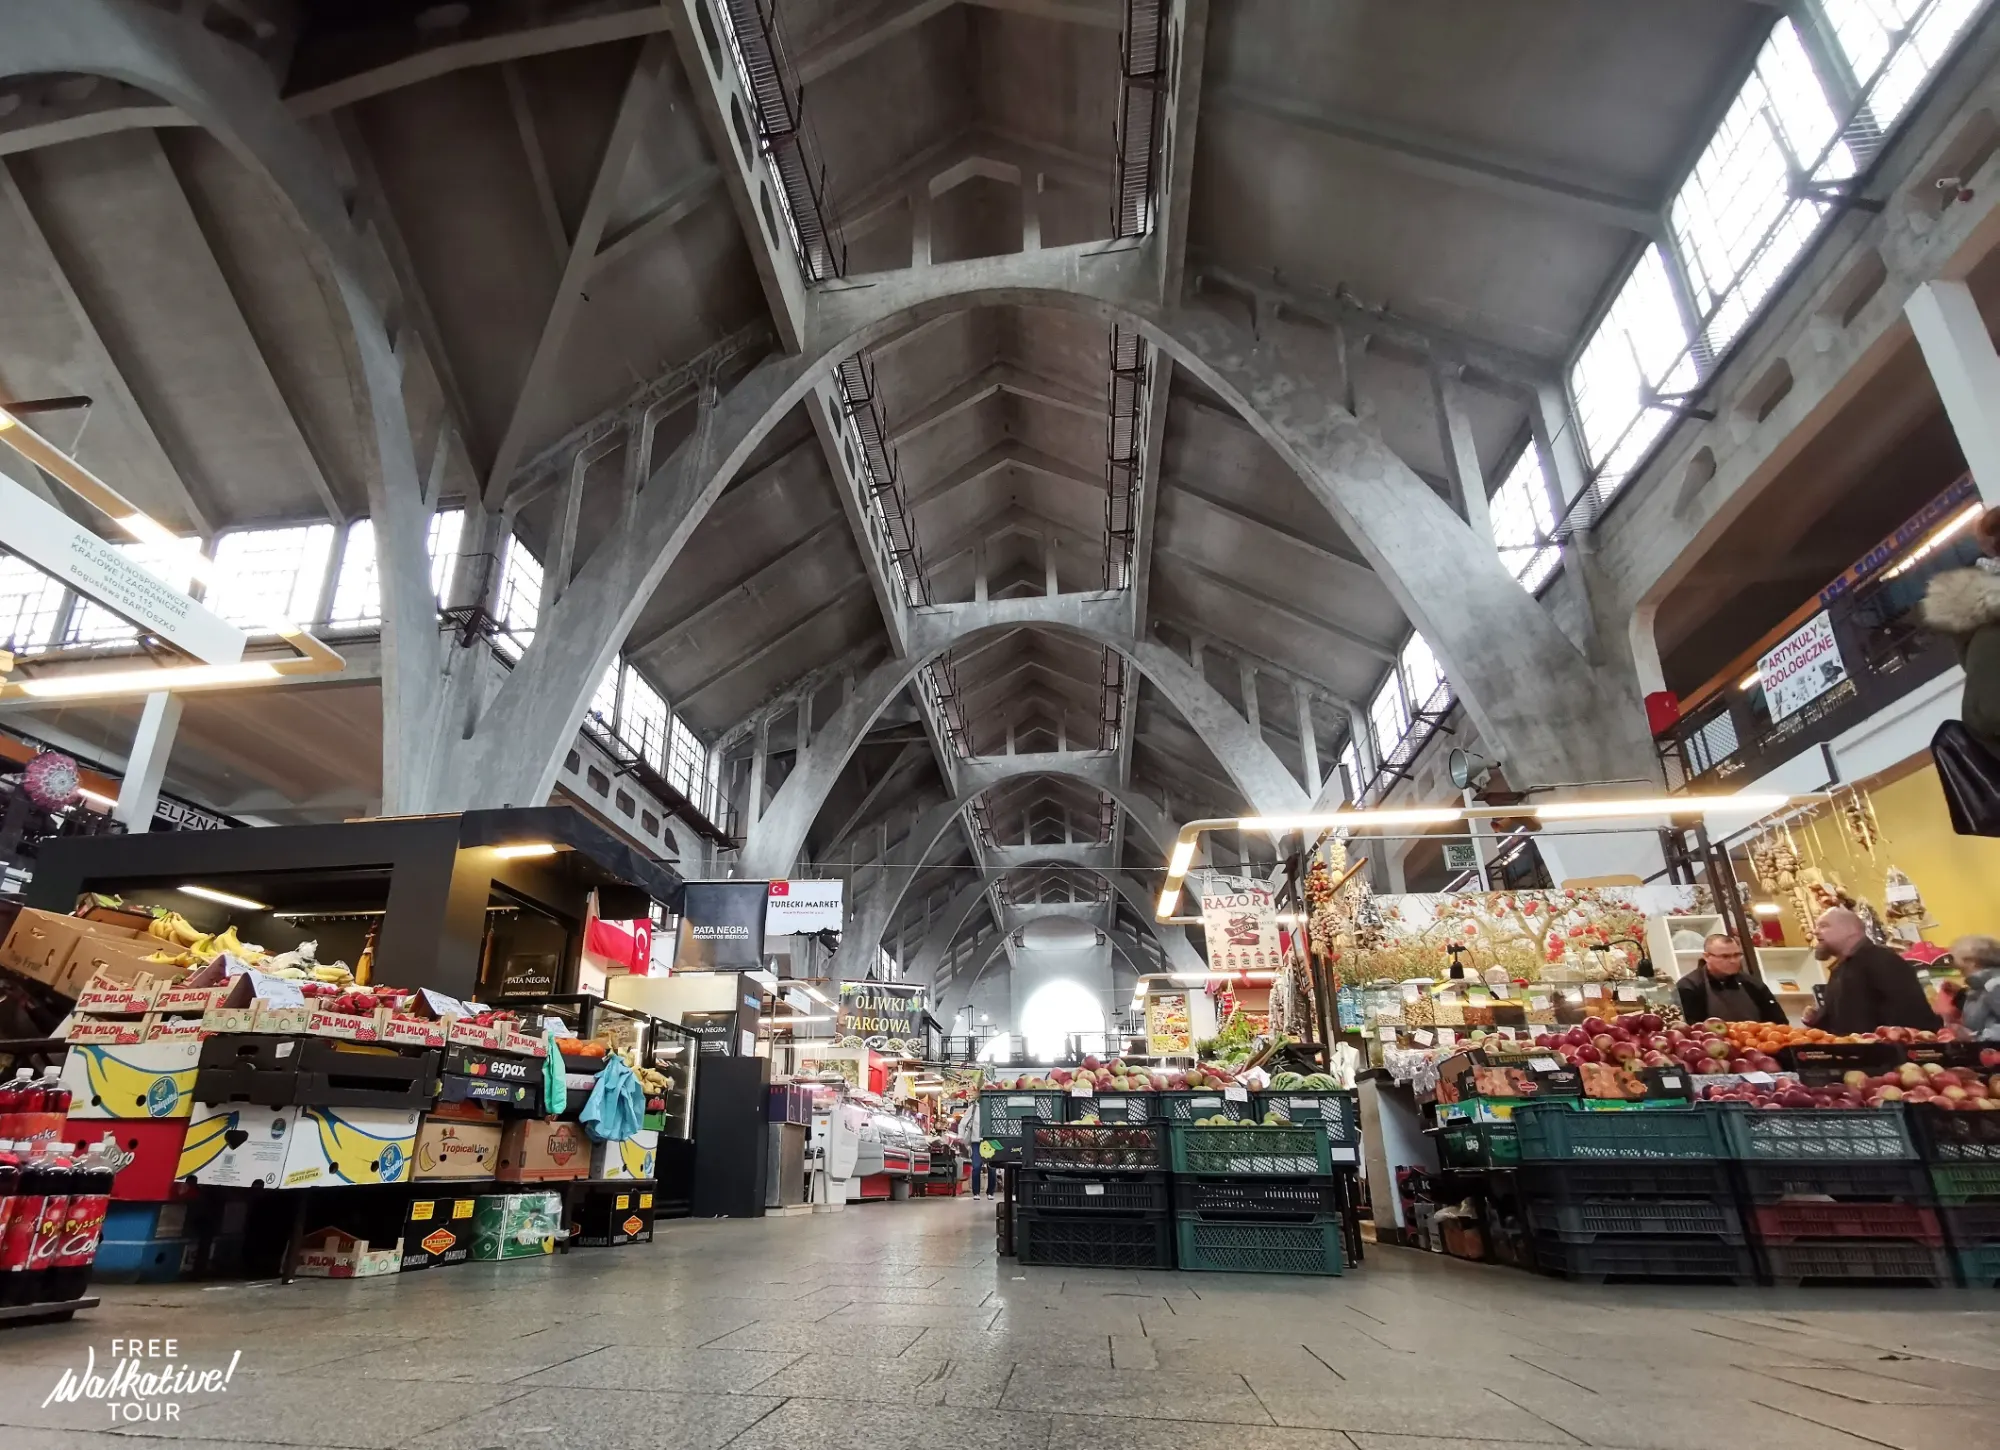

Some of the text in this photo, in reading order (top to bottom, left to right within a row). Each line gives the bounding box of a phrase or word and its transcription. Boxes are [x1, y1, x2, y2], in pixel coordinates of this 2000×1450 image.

[74, 534, 97, 552] ART.
[71, 542, 119, 577] KRAJOWE
[125, 576, 187, 619] ZAGRANICZNE
[103, 575, 153, 609] stoisko 115
[122, 596, 176, 632] BARTOSZKO
[1768, 624, 1817, 671] ARTYKUŁY
[1764, 634, 1834, 692] ZOOLOGICZNE
[770, 900, 839, 908] TURECKI MARKET
[1203, 894, 1262, 910] RAZOR
[693, 926, 749, 934] PATA NEGRA
[507, 976, 550, 984] PATA NEGRA
[855, 995, 905, 1012] OLIWKI
[321, 1016, 333, 1027] EL
[395, 1023, 405, 1034] EL
[845, 1015, 911, 1033] TARGOWA
[491, 1062, 527, 1079] espax
